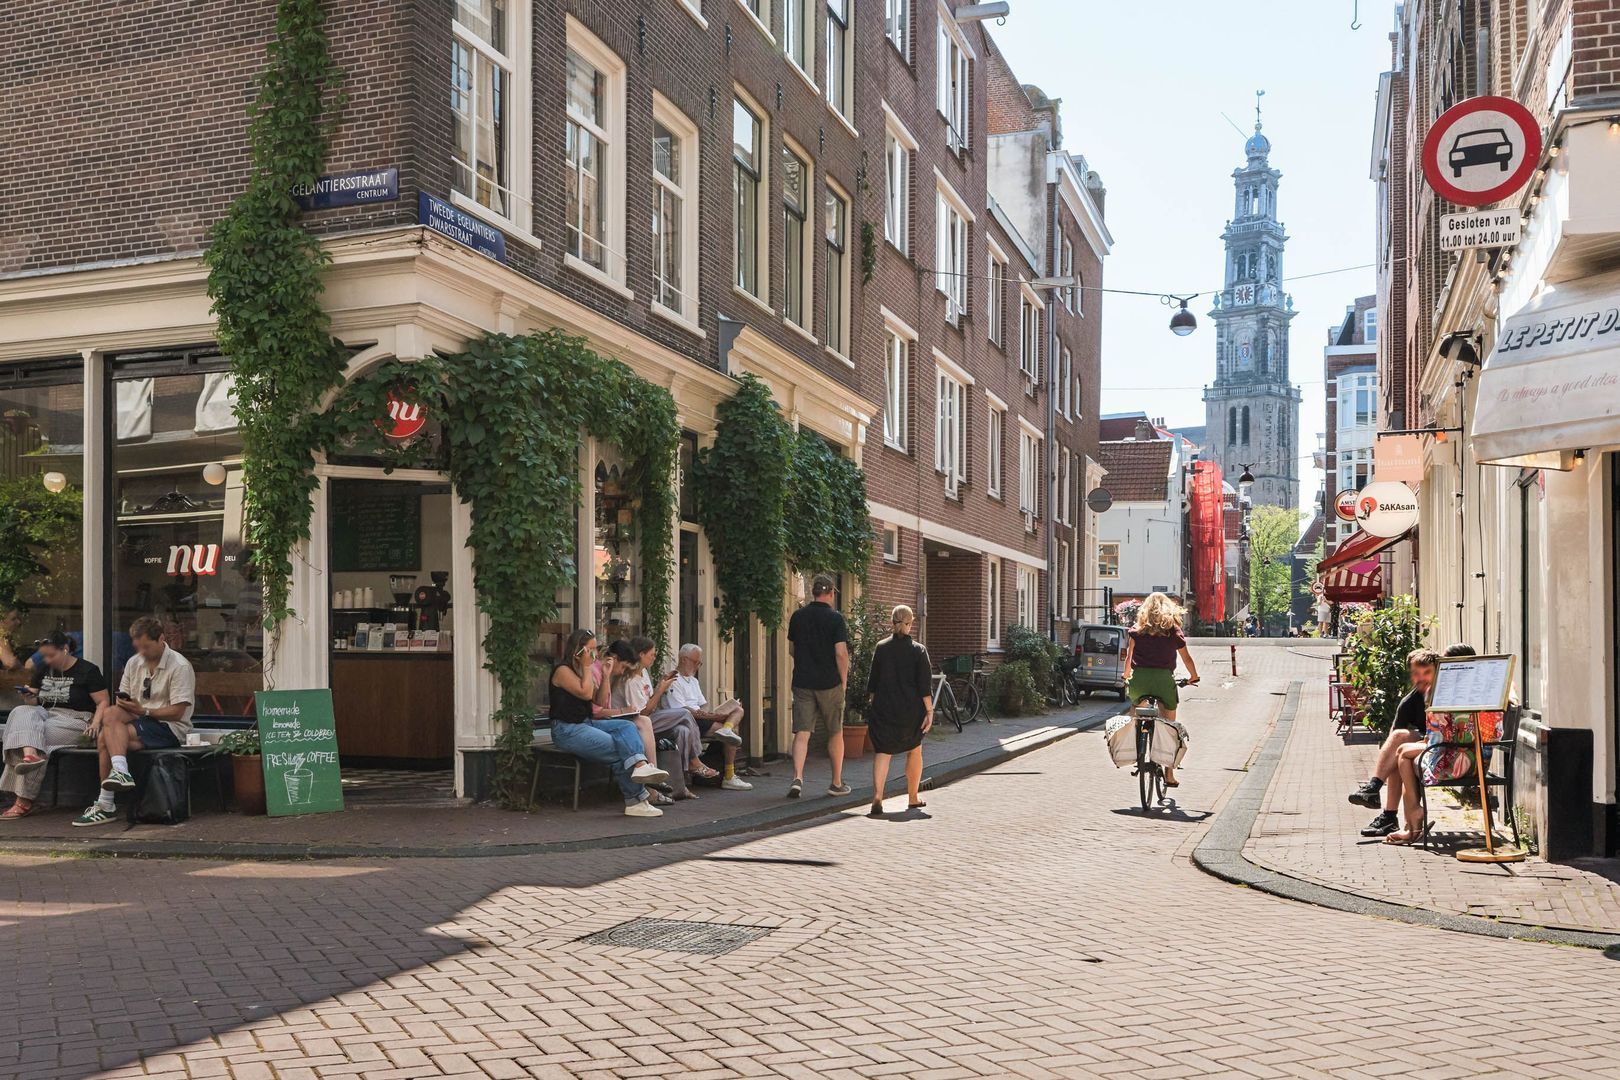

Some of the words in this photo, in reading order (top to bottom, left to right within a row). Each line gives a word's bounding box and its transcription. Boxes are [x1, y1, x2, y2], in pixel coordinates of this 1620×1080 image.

[288, 172, 388, 197] GELANTIERSSTRAAT
[356, 188, 389, 199] CENTRUM
[428, 198, 455, 222] TWEEDE
[457, 213, 497, 243] EGELANTIERS
[1448, 215, 1491, 231] Gesloten
[1494, 215, 1511, 226] van
[429, 214, 473, 246] DWARSSTRAAT
[1441, 234, 1462, 248] 11.00
[1464, 234, 1476, 246] tot
[1478, 231, 1500, 244] 24.00
[1502, 232, 1516, 242] uur
[1498, 326, 1531, 353] LE
[1525, 311, 1600, 348] PETIT
[1596, 308, 1620, 335] D
[1512, 385, 1548, 402] always
[1551, 384, 1559, 395] a
[1561, 374, 1592, 394] good
[1379, 503, 1416, 512] SAKAsan
[166, 544, 220, 577] nu
[262, 700, 300, 716] homemade
[272, 718, 301, 729] lemonade
[277, 731, 291, 739] TEA
[306, 751, 337, 765] COFFEE
